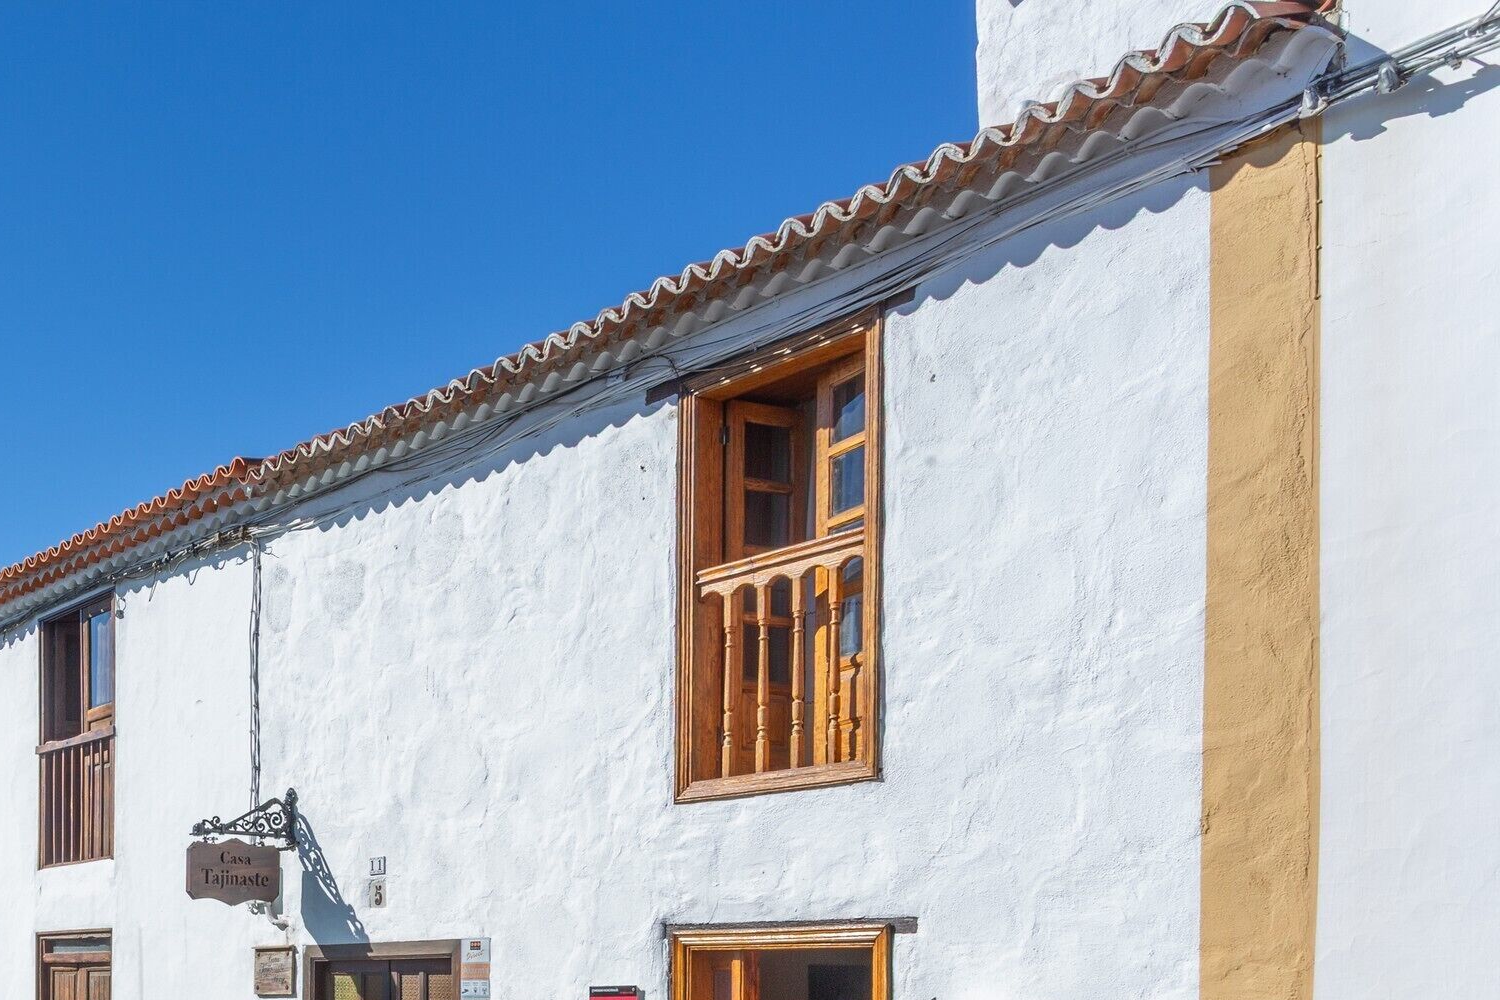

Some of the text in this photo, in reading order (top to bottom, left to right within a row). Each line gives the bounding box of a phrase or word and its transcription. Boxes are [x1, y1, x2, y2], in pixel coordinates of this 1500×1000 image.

[220, 851, 252, 865] Casa
[370, 860, 382, 871] 11
[201, 868, 269, 889] Tajinaste
[375, 885, 382, 906] 5
